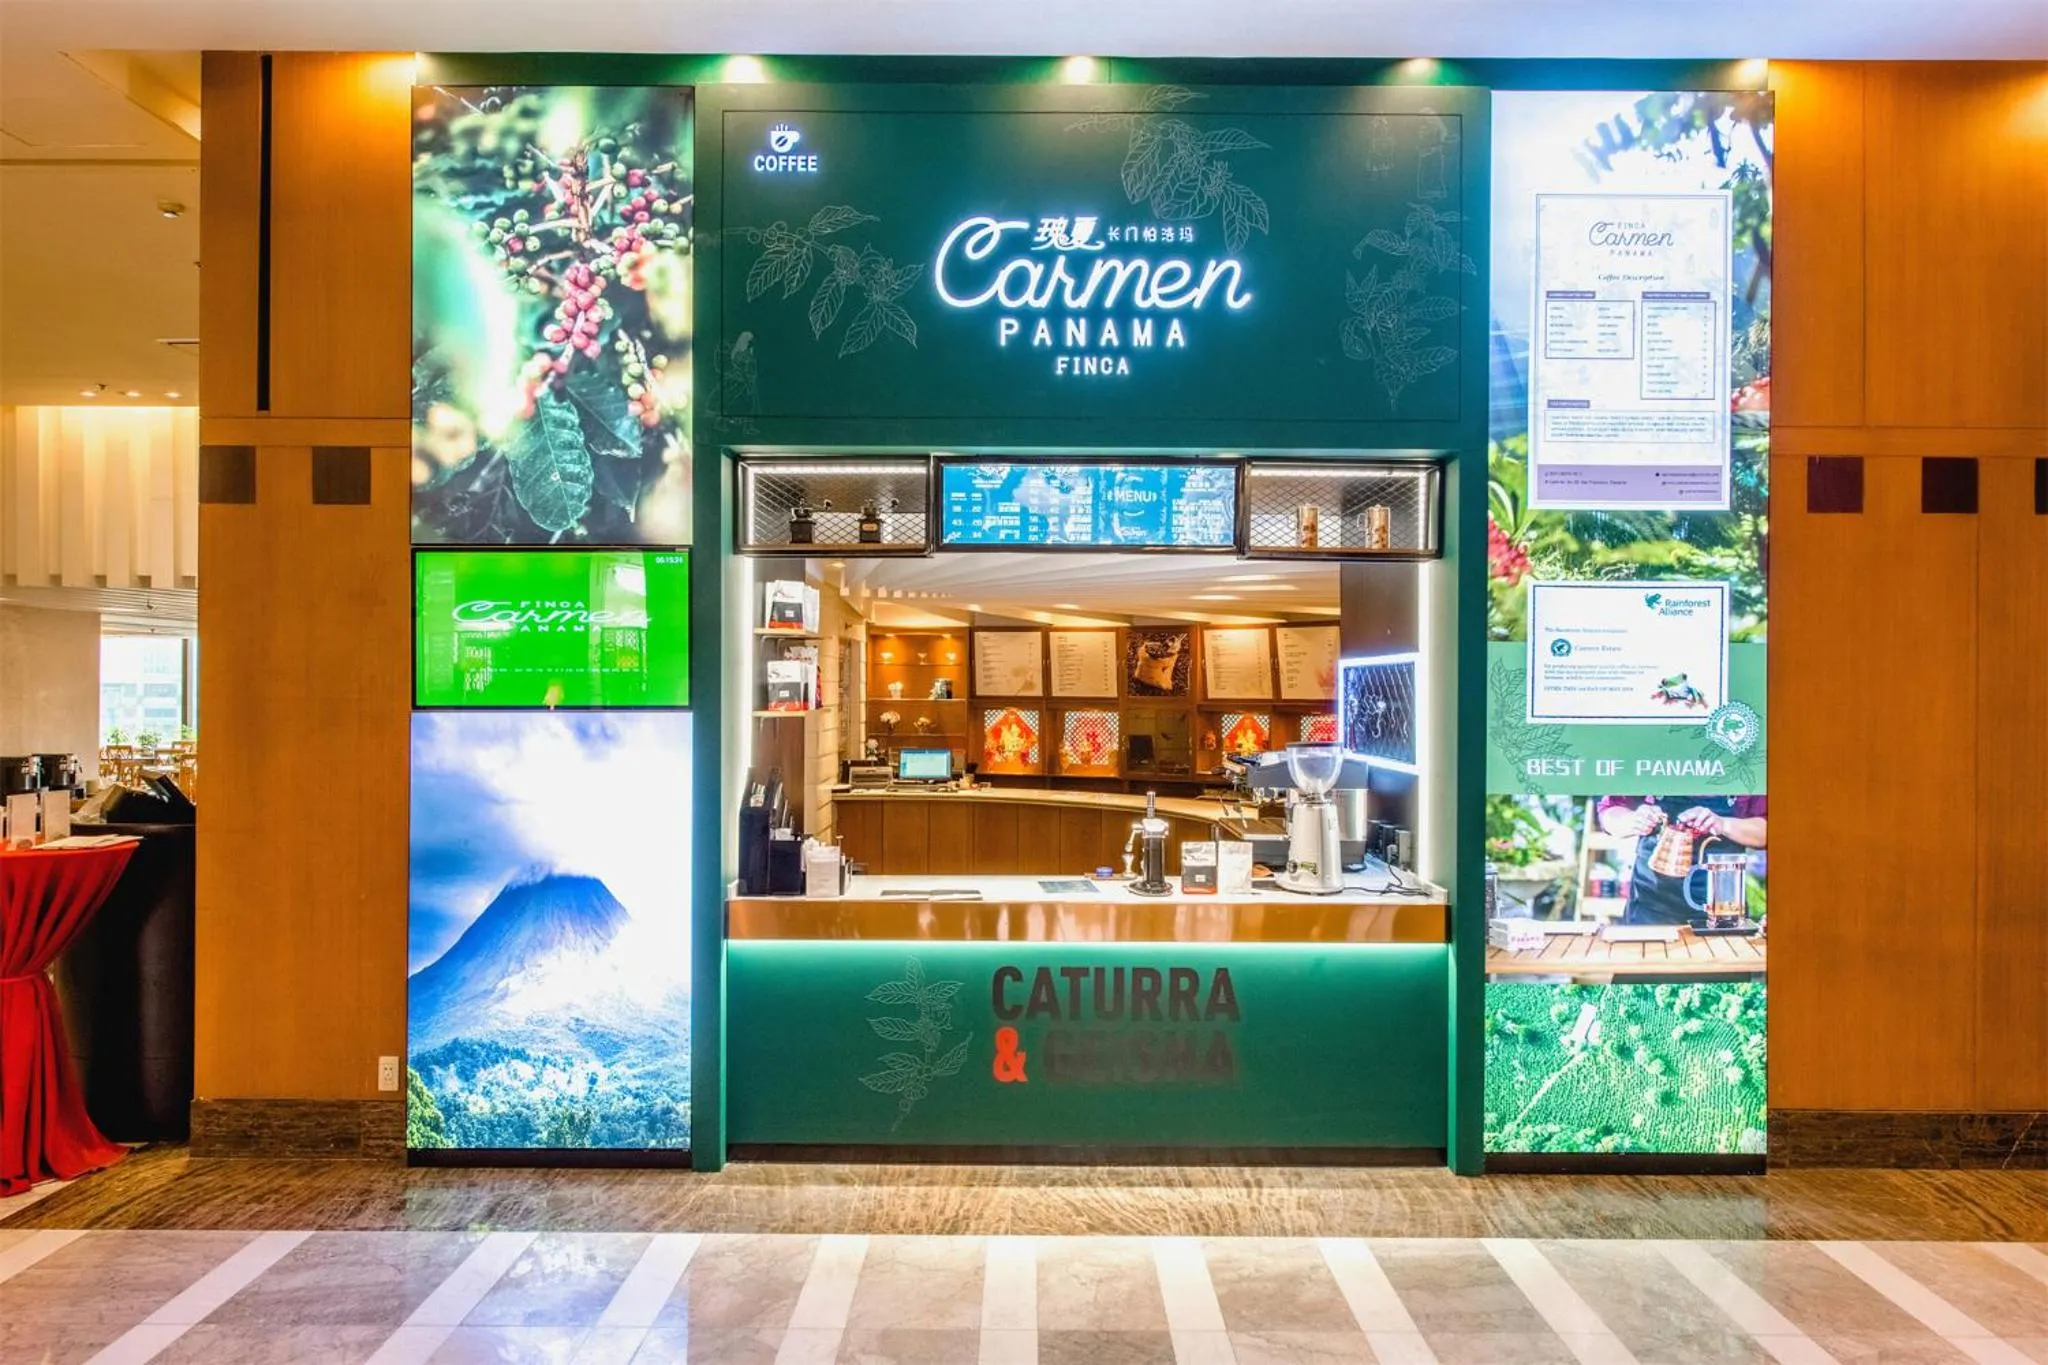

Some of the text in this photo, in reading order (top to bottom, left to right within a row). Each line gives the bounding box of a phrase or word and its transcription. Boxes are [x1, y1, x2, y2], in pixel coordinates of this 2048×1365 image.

[754, 155, 818, 173] COFFEE
[1588, 221, 1674, 247] Carmen
[934, 216, 1252, 309] Carmen
[999, 318, 1187, 347] PANAMA
[1055, 356, 1130, 376] FINCA
[1116, 490, 1151, 503] MENU
[1657, 607, 1694, 617] Alliance
[1664, 598, 1711, 608] Rainforest
[1526, 758, 1726, 777] BEST OF PANAMA
[991, 965, 1241, 1022] CATURRA
[992, 1026, 1029, 1083] &
